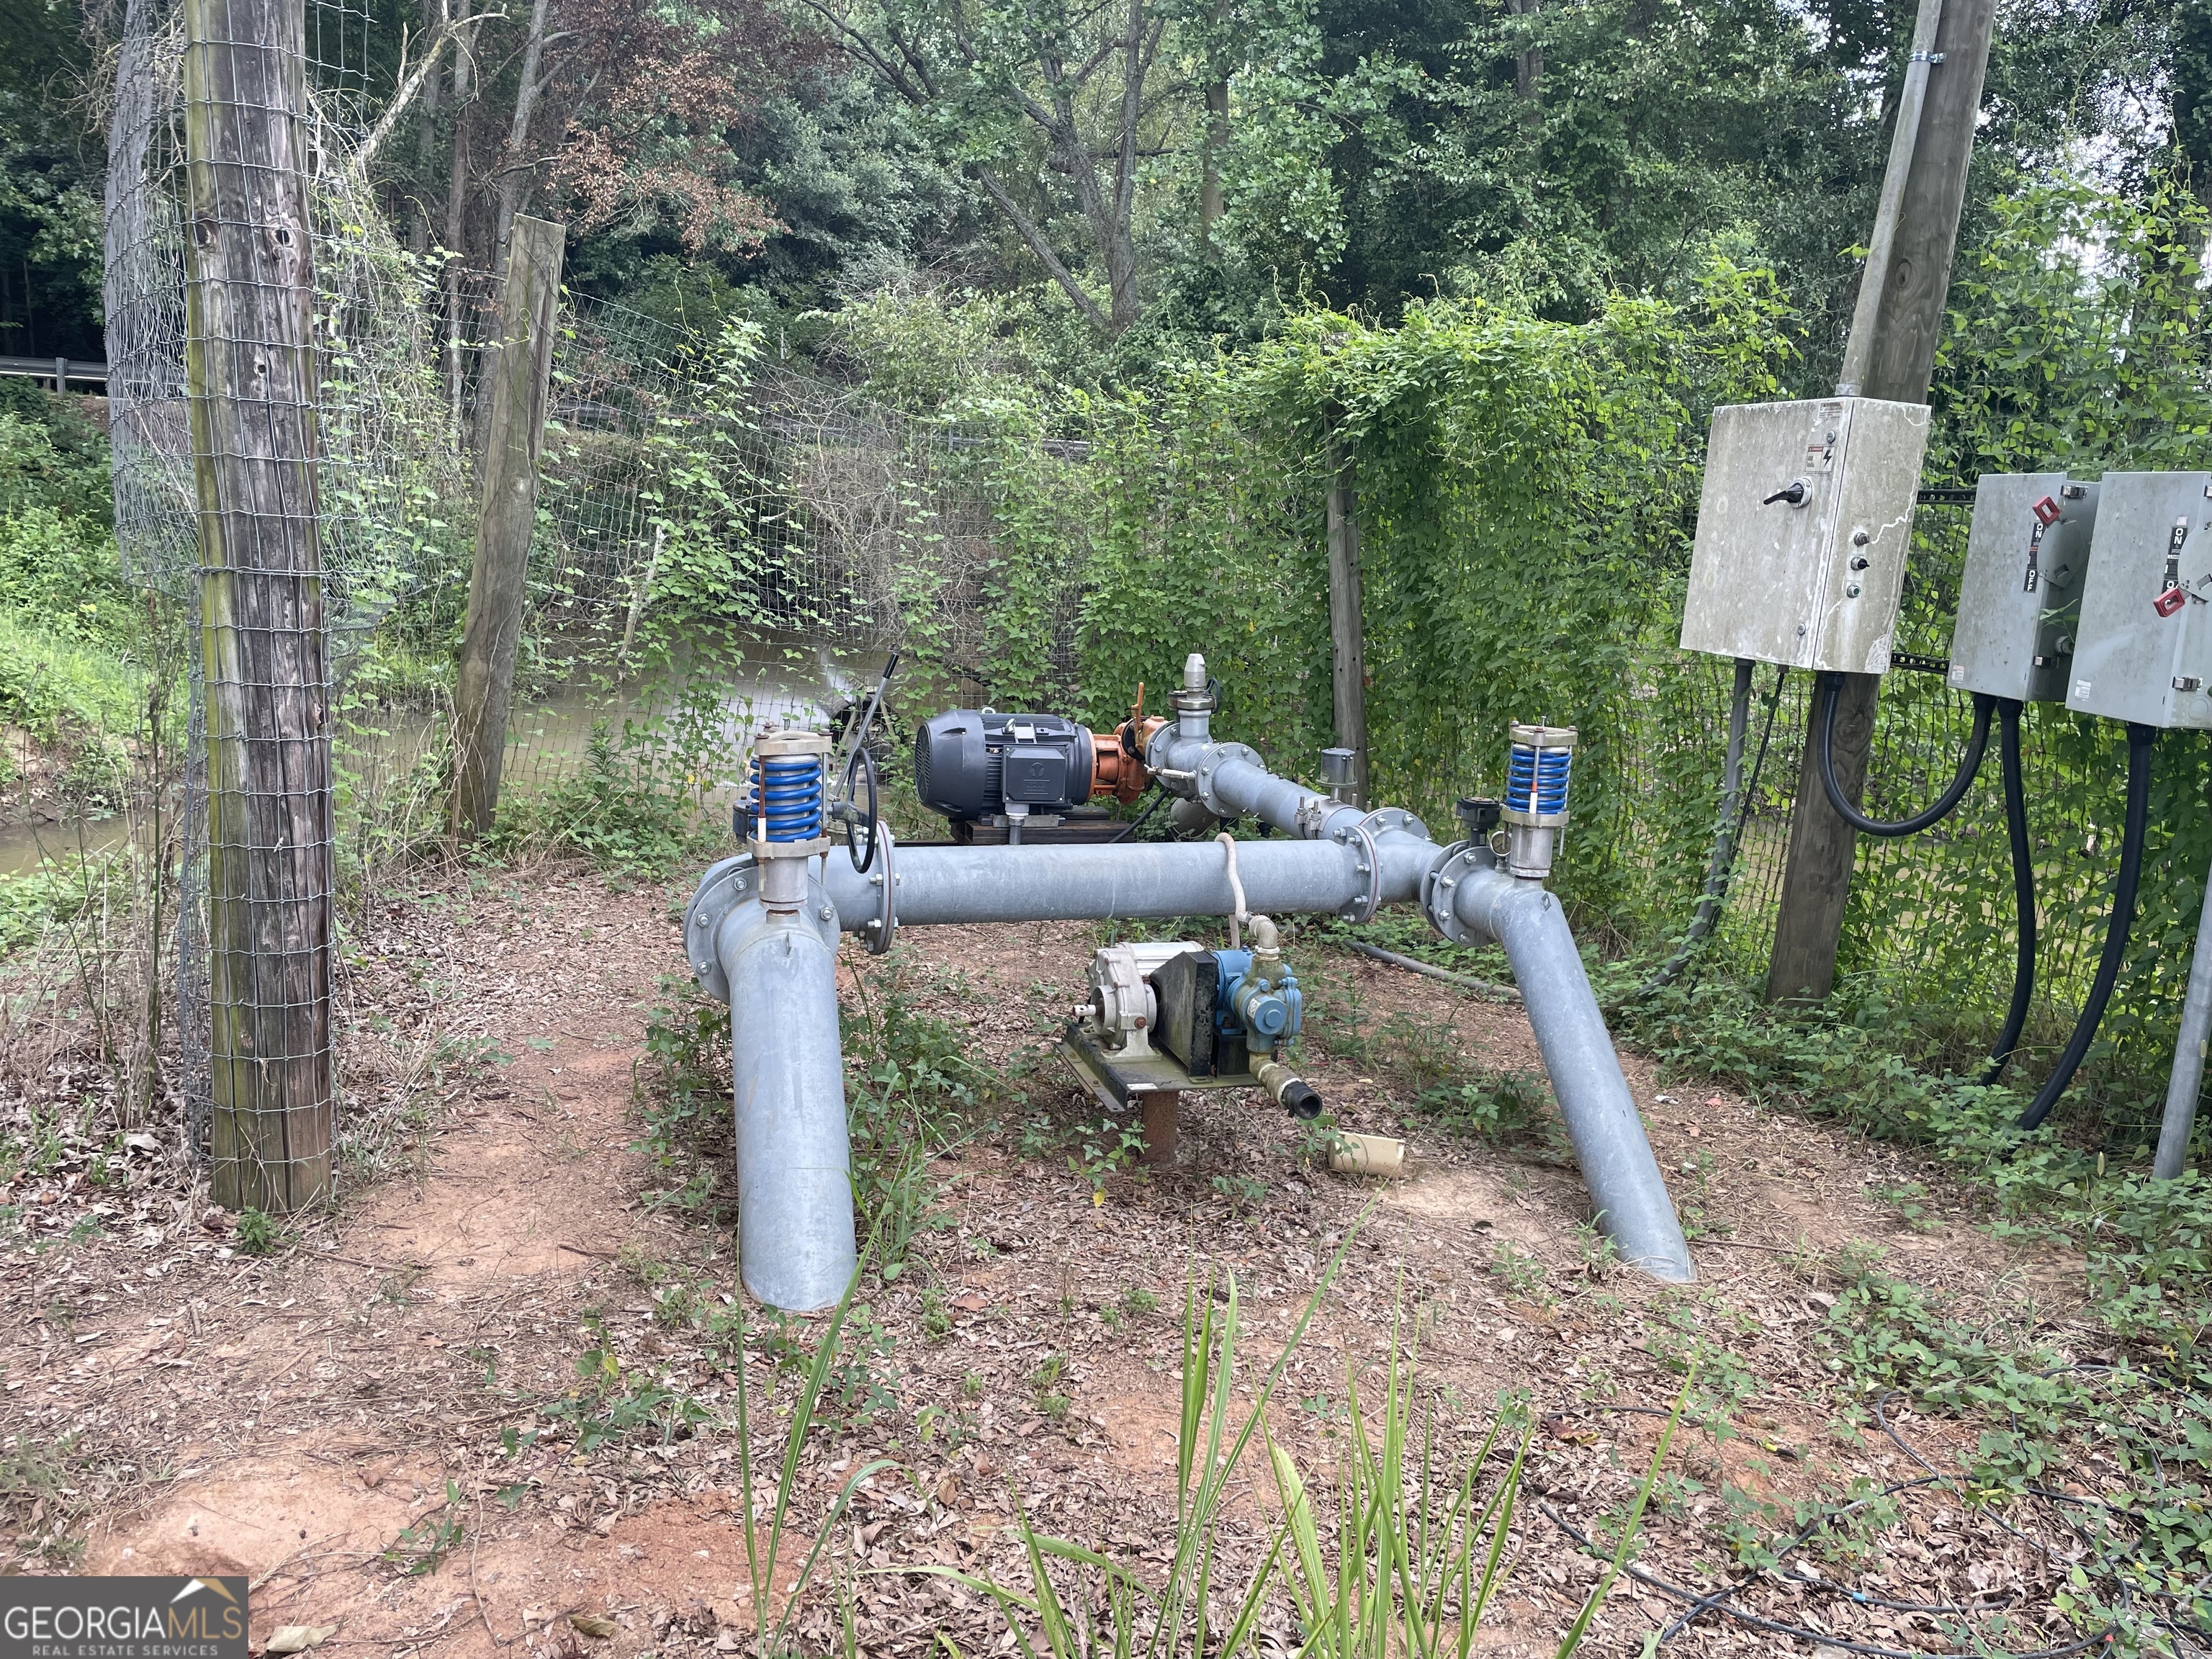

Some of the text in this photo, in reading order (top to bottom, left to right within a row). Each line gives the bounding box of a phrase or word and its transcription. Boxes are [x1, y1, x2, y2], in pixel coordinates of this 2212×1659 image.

[2035, 523, 2044, 539] ON
[2174, 528, 2184, 544] ON
[2027, 570, 2036, 591] OFF
